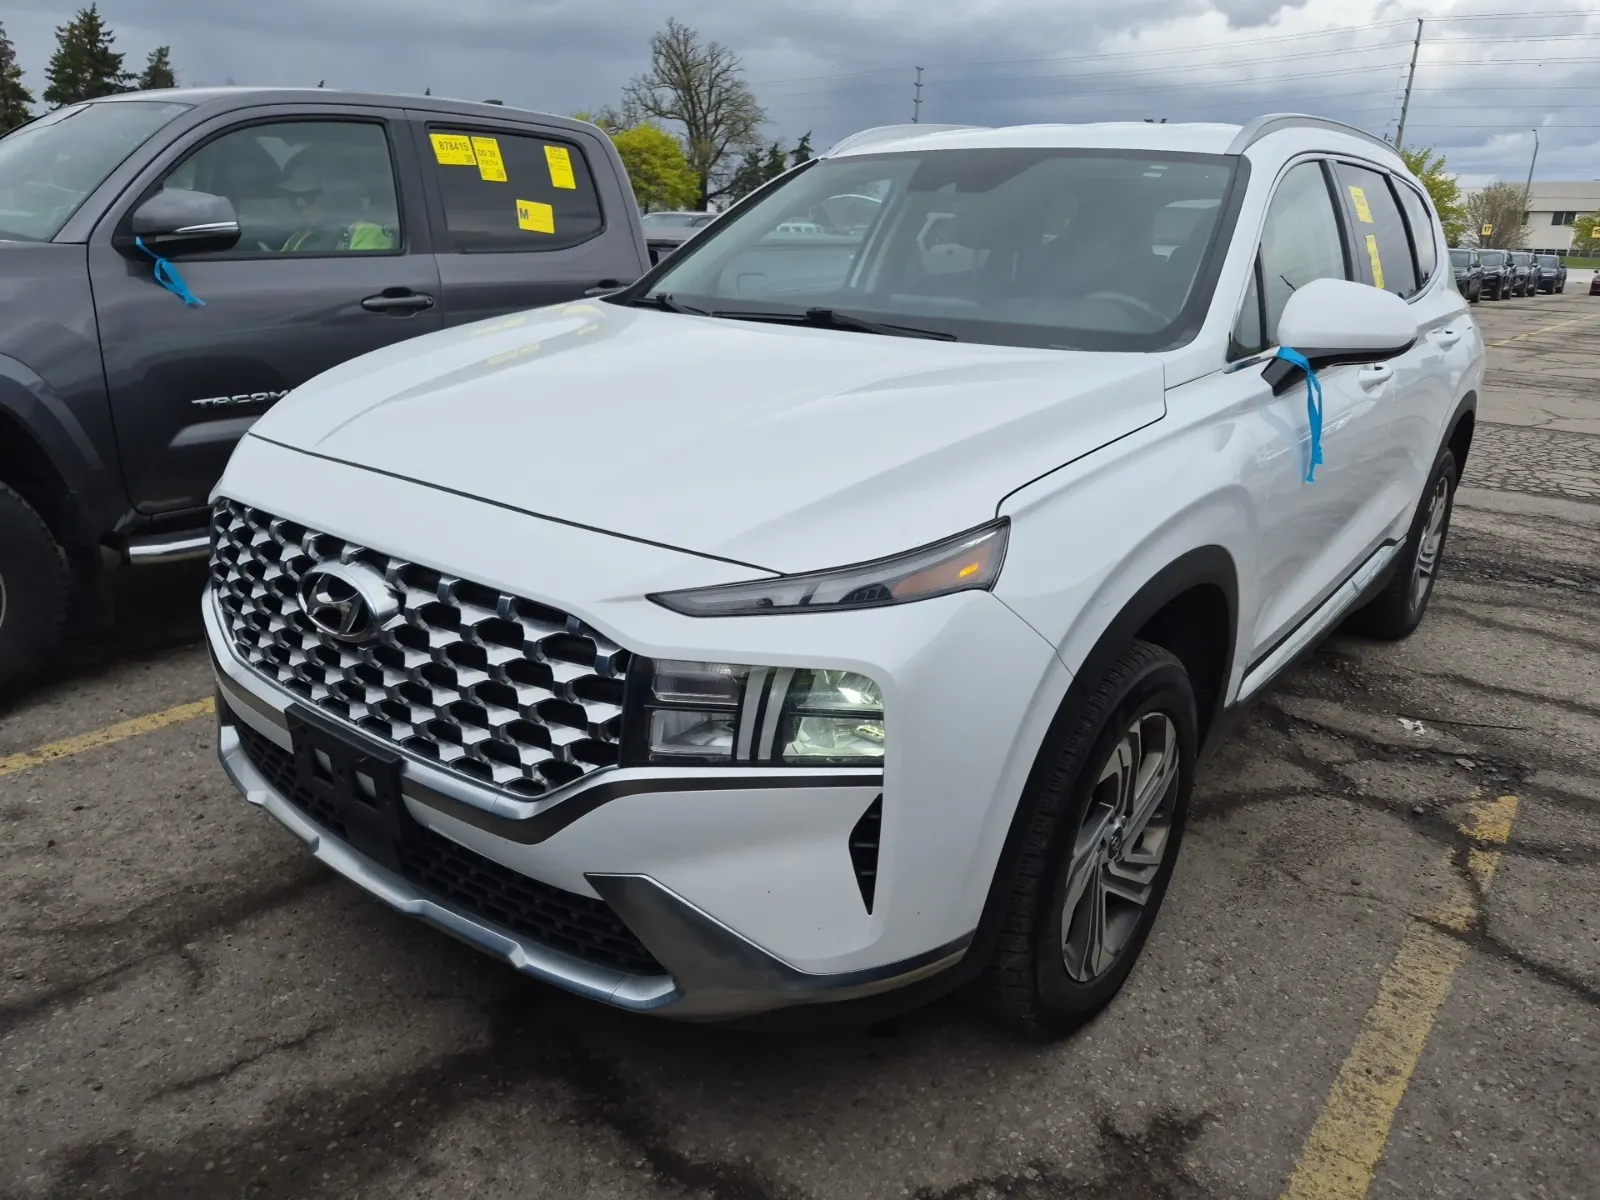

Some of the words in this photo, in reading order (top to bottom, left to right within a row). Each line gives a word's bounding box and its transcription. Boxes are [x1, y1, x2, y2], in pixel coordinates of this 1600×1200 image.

[438, 141, 469, 152] 878415
[519, 208, 529, 220] M
[191, 390, 289, 407] TACOM
